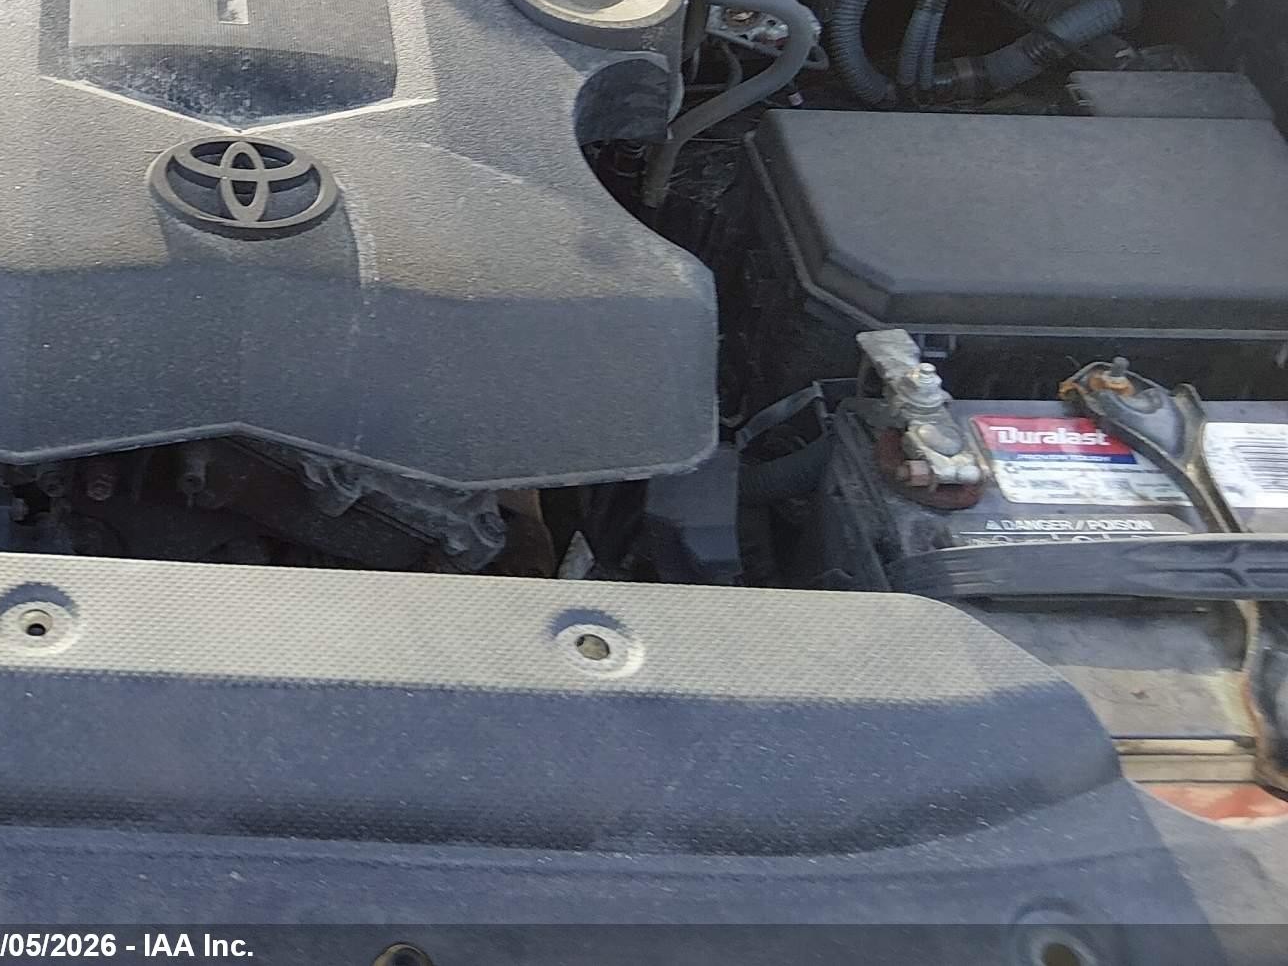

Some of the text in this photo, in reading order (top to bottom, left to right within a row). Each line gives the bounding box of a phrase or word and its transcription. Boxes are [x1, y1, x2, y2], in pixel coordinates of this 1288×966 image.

[989, 425, 1111, 446] Duralast
[1001, 519, 1073, 531] DANGER
[1088, 520, 1155, 531] POISON
